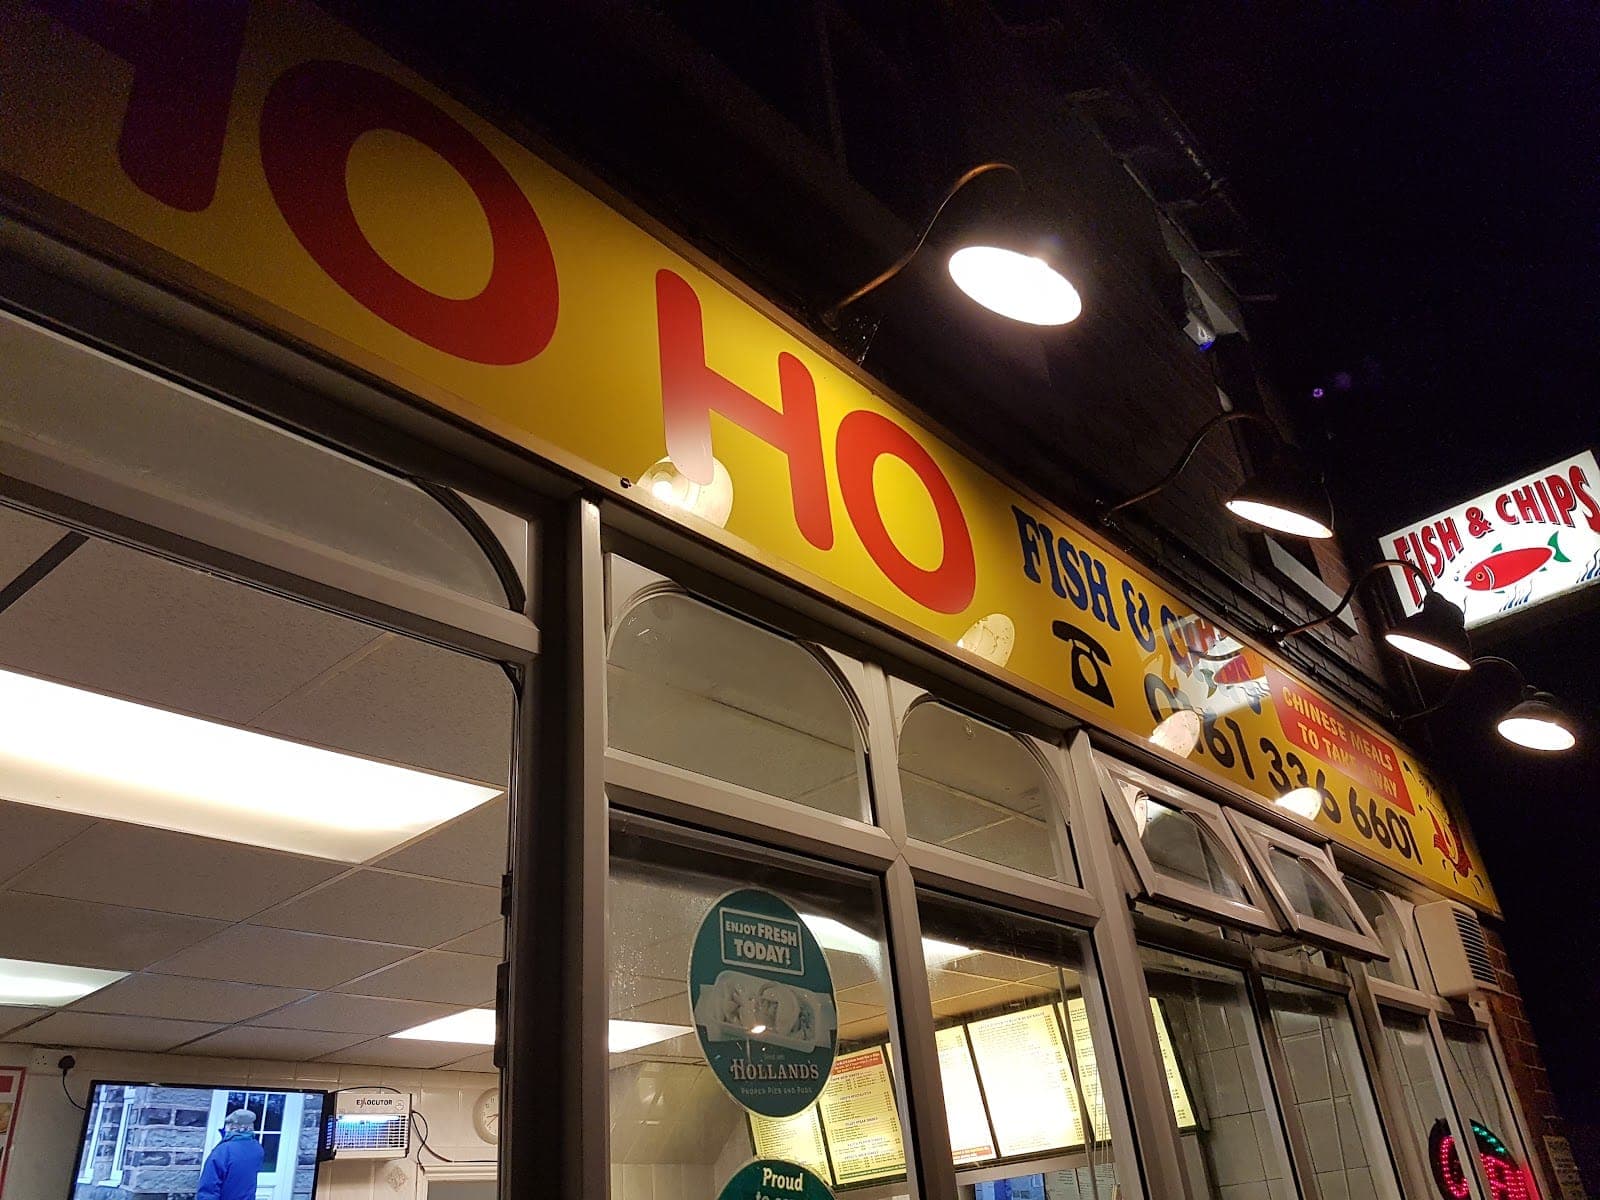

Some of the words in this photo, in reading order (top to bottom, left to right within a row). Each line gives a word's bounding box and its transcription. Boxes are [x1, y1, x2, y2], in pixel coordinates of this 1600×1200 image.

[655, 268, 976, 615] HO
[1392, 517, 1464, 609] FISH
[1465, 506, 1495, 539] &
[1495, 465, 1600, 534] CHIPS
[1011, 504, 1120, 632] FISH
[1121, 578, 1156, 653] &
[1143, 672, 1255, 780] 061
[1259, 737, 1342, 824] 336
[1349, 786, 1423, 865] 6601
[1282, 686, 1347, 742] CHINESE
[1349, 730, 1393, 772] MEALS
[1297, 722, 1320, 750] TO
[1362, 763, 1398, 799] WAY
[725, 920, 757, 936] ENJOY
[757, 923, 798, 947] FRESH
[734, 938, 791, 966] TODAY!
[730, 1058, 820, 1081] HOLLAND'S
[762, 1167, 804, 1192] Proud
